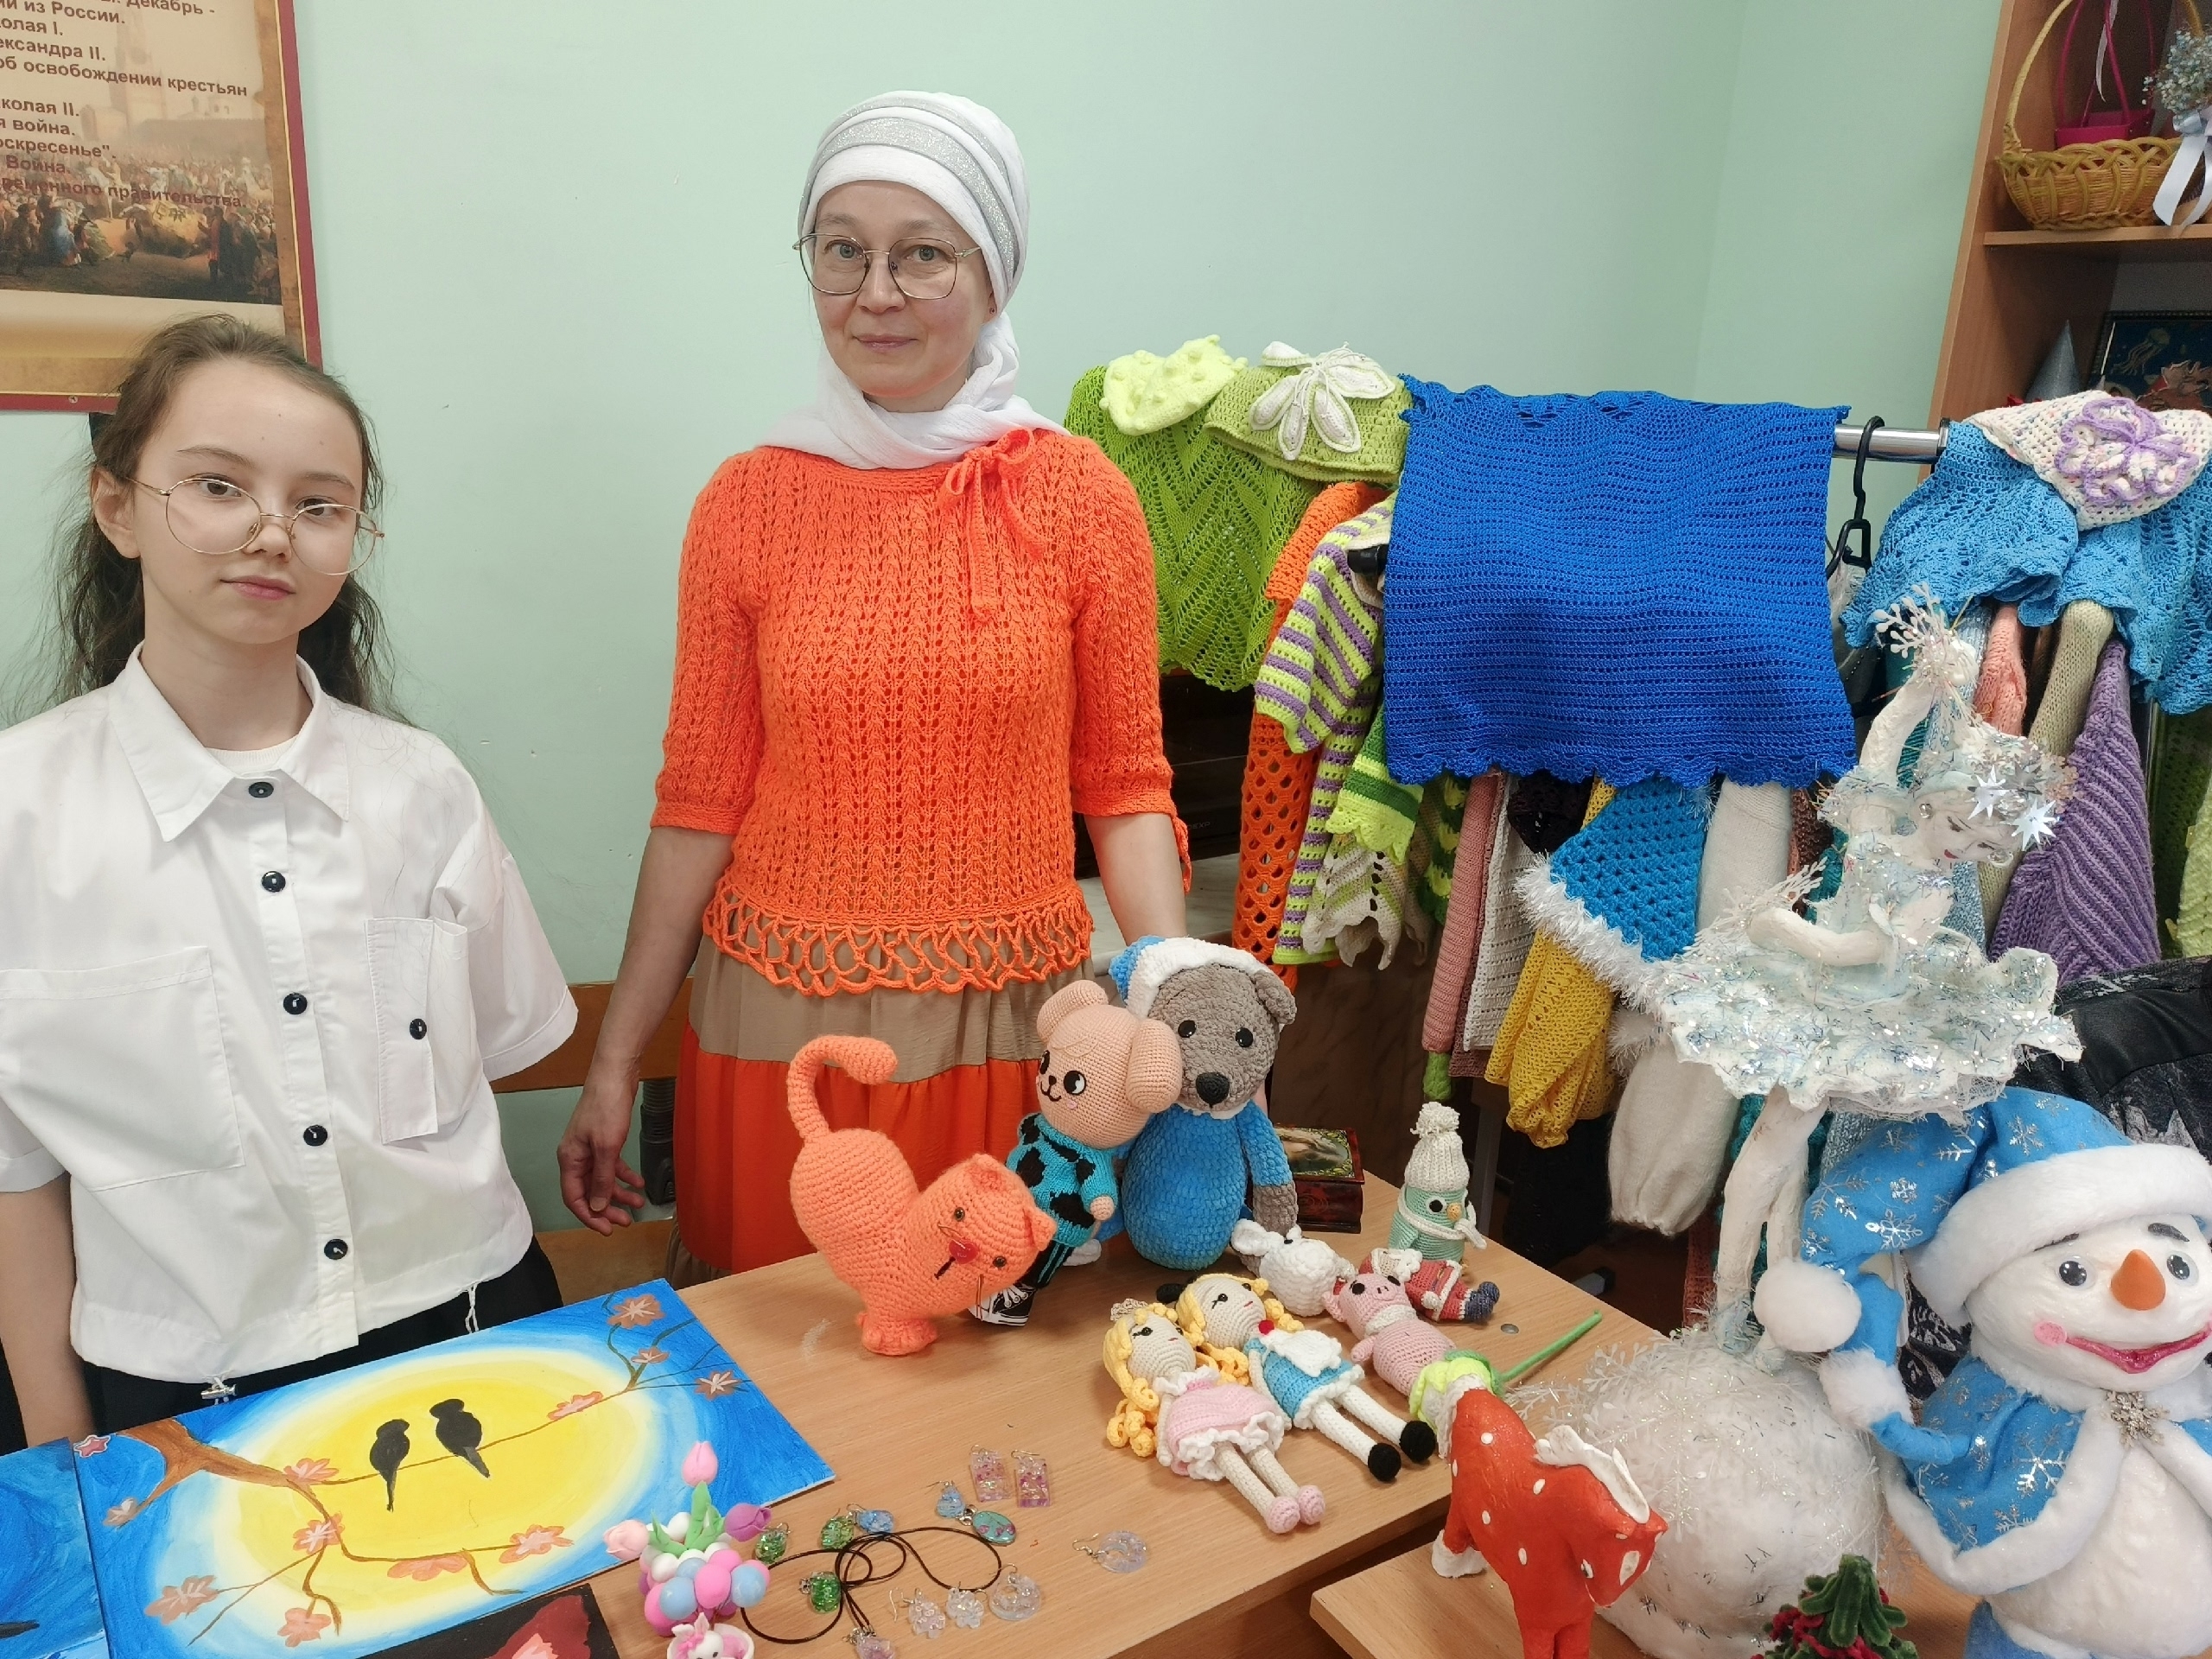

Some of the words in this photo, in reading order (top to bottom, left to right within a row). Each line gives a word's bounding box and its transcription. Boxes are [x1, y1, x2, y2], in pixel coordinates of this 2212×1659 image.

[24, 1, 46, 13] из
[52, 1, 125, 24] России.
[0, 17, 48, 34] олая
[23, 61, 162, 86] освобождении
[168, 78, 247, 97] крестьян
[0, 98, 57, 115] колая
[12, 118, 76, 136] война.
[108, 185, 247, 208] правительства.
